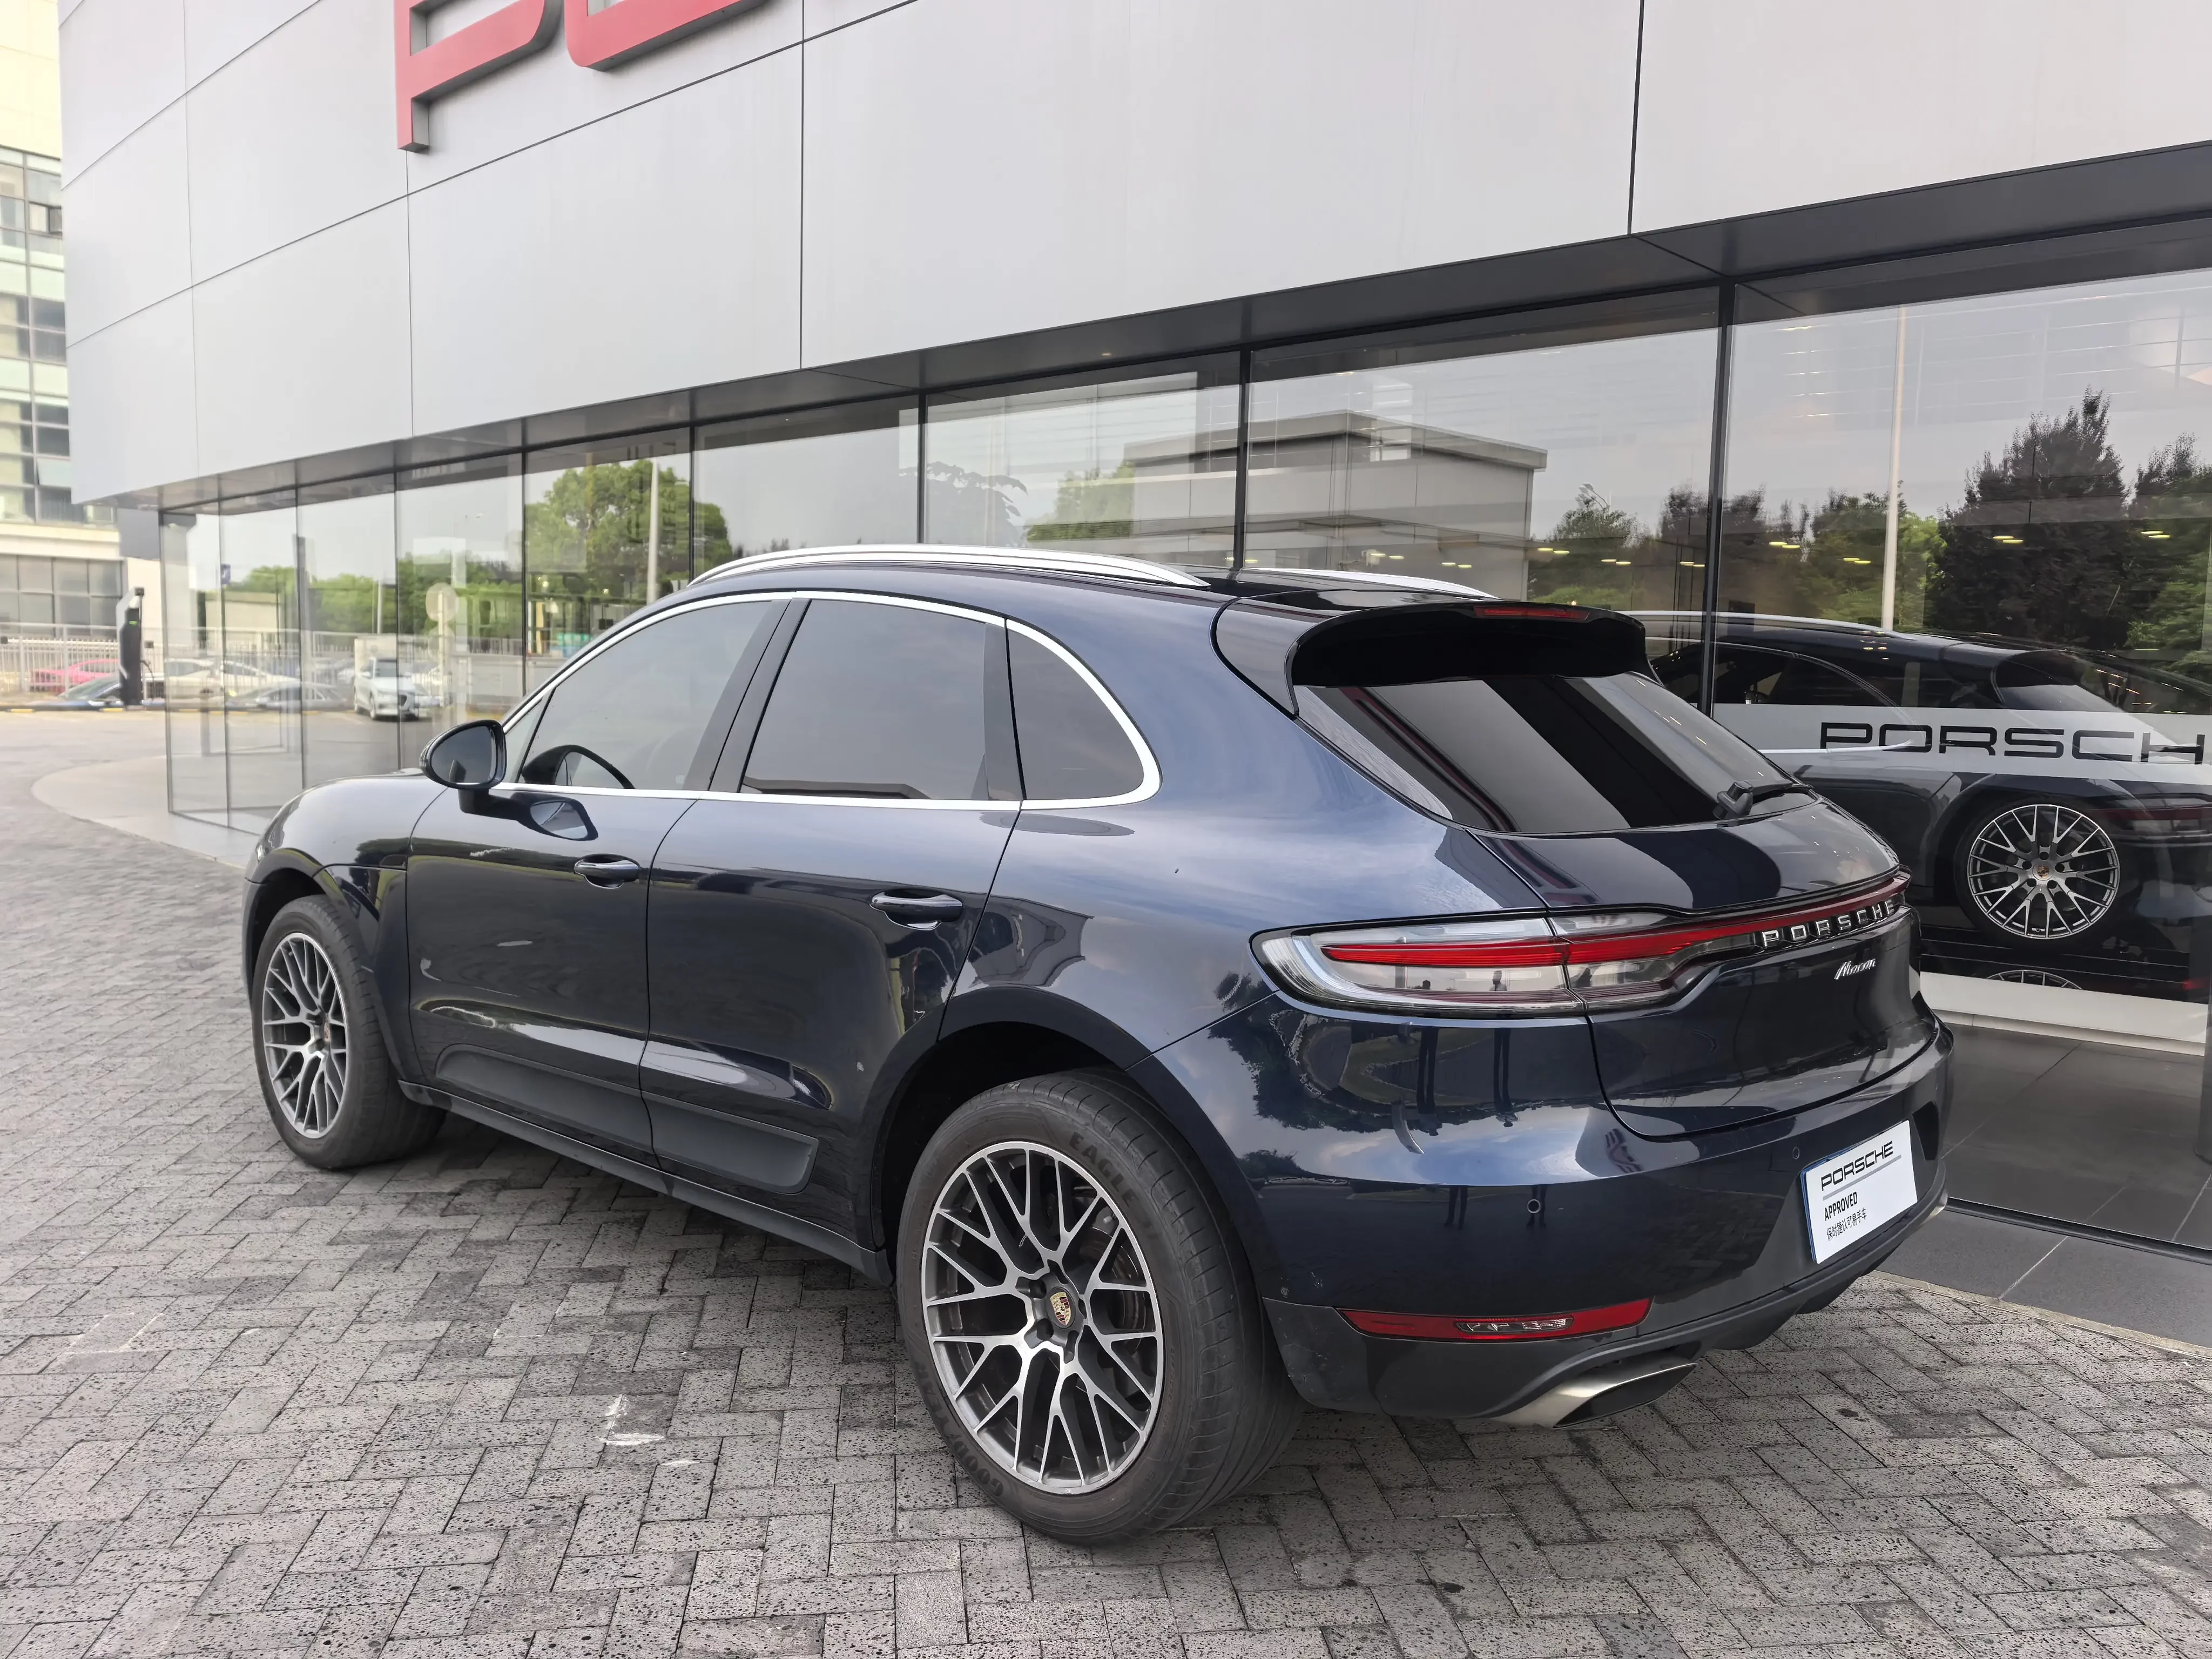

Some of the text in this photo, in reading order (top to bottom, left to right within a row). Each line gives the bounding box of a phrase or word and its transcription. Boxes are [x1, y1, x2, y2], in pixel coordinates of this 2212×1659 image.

[1762, 899, 1894, 947] PORSCHE
[1833, 957, 1876, 980] Macan
[1069, 1131, 1139, 1208] EAGLE
[1820, 1141, 1894, 1191] PORSCHE
[1824, 1191, 1858, 1221] APPROVED
[1826, 1207, 1867, 1242] 保时捷认可易手车
